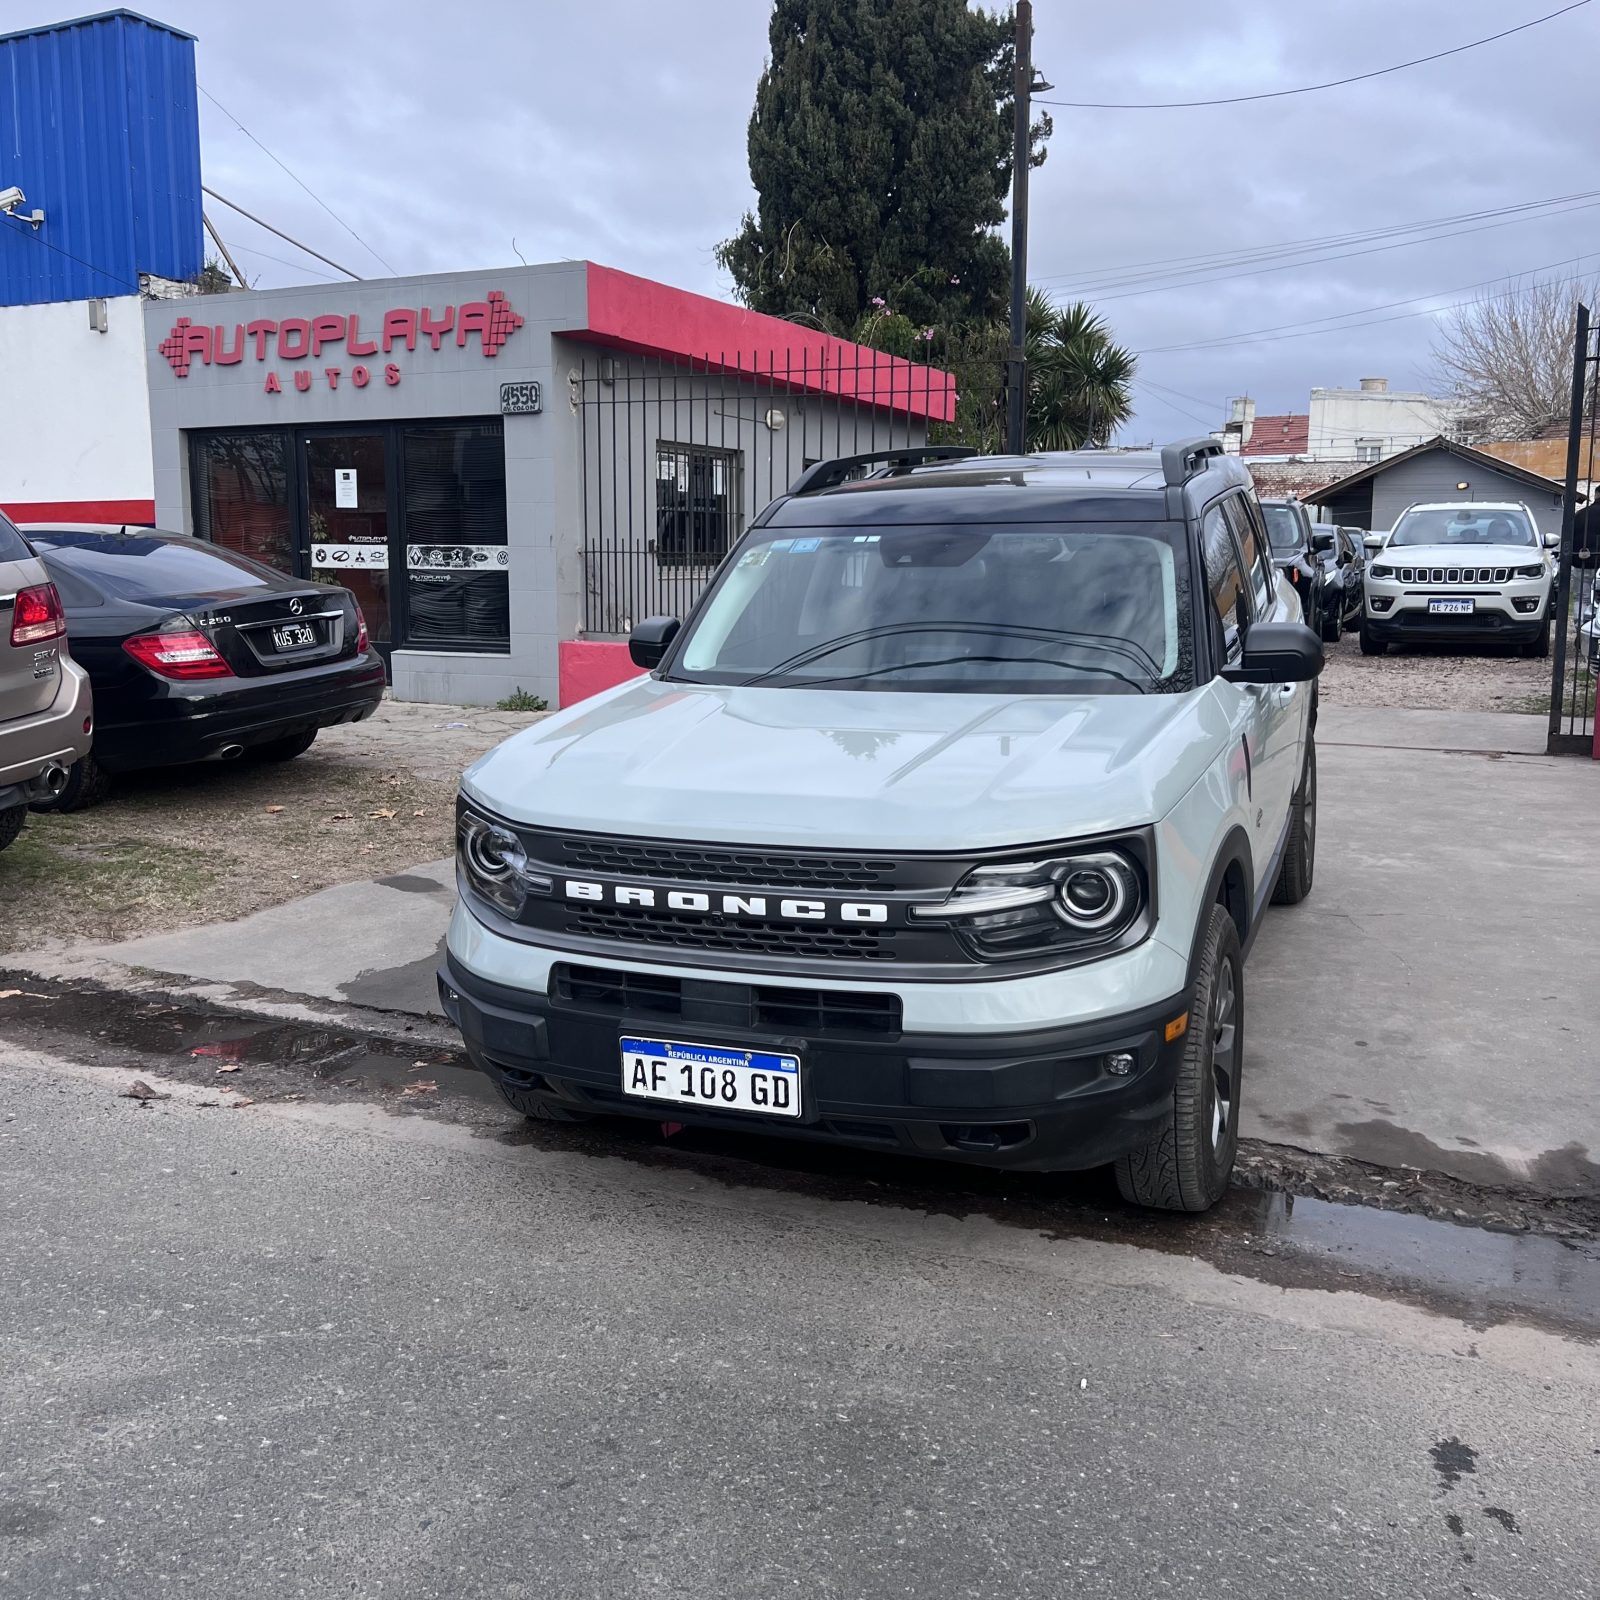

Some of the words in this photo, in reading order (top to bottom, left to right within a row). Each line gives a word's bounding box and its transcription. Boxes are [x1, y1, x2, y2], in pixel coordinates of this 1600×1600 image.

[182, 301, 497, 365] AUTOPLAYA
[264, 362, 400, 393] AUTOS
[502, 385, 538, 406] 4550
[1431, 604, 1441, 612] AE
[1443, 604, 1459, 612] 726
[1460, 604, 1471, 612] NF
[273, 630, 293, 647] KUS
[295, 627, 313, 643] 320
[34, 649, 56, 660] SRV
[565, 880, 888, 922] BRONCO
[667, 1050, 707, 1063] REPÚBLICA
[708, 1055, 750, 1067] ARGENTINA
[631, 1058, 668, 1091] AF
[680, 1064, 737, 1102] 108
[750, 1073, 790, 1108] GD
